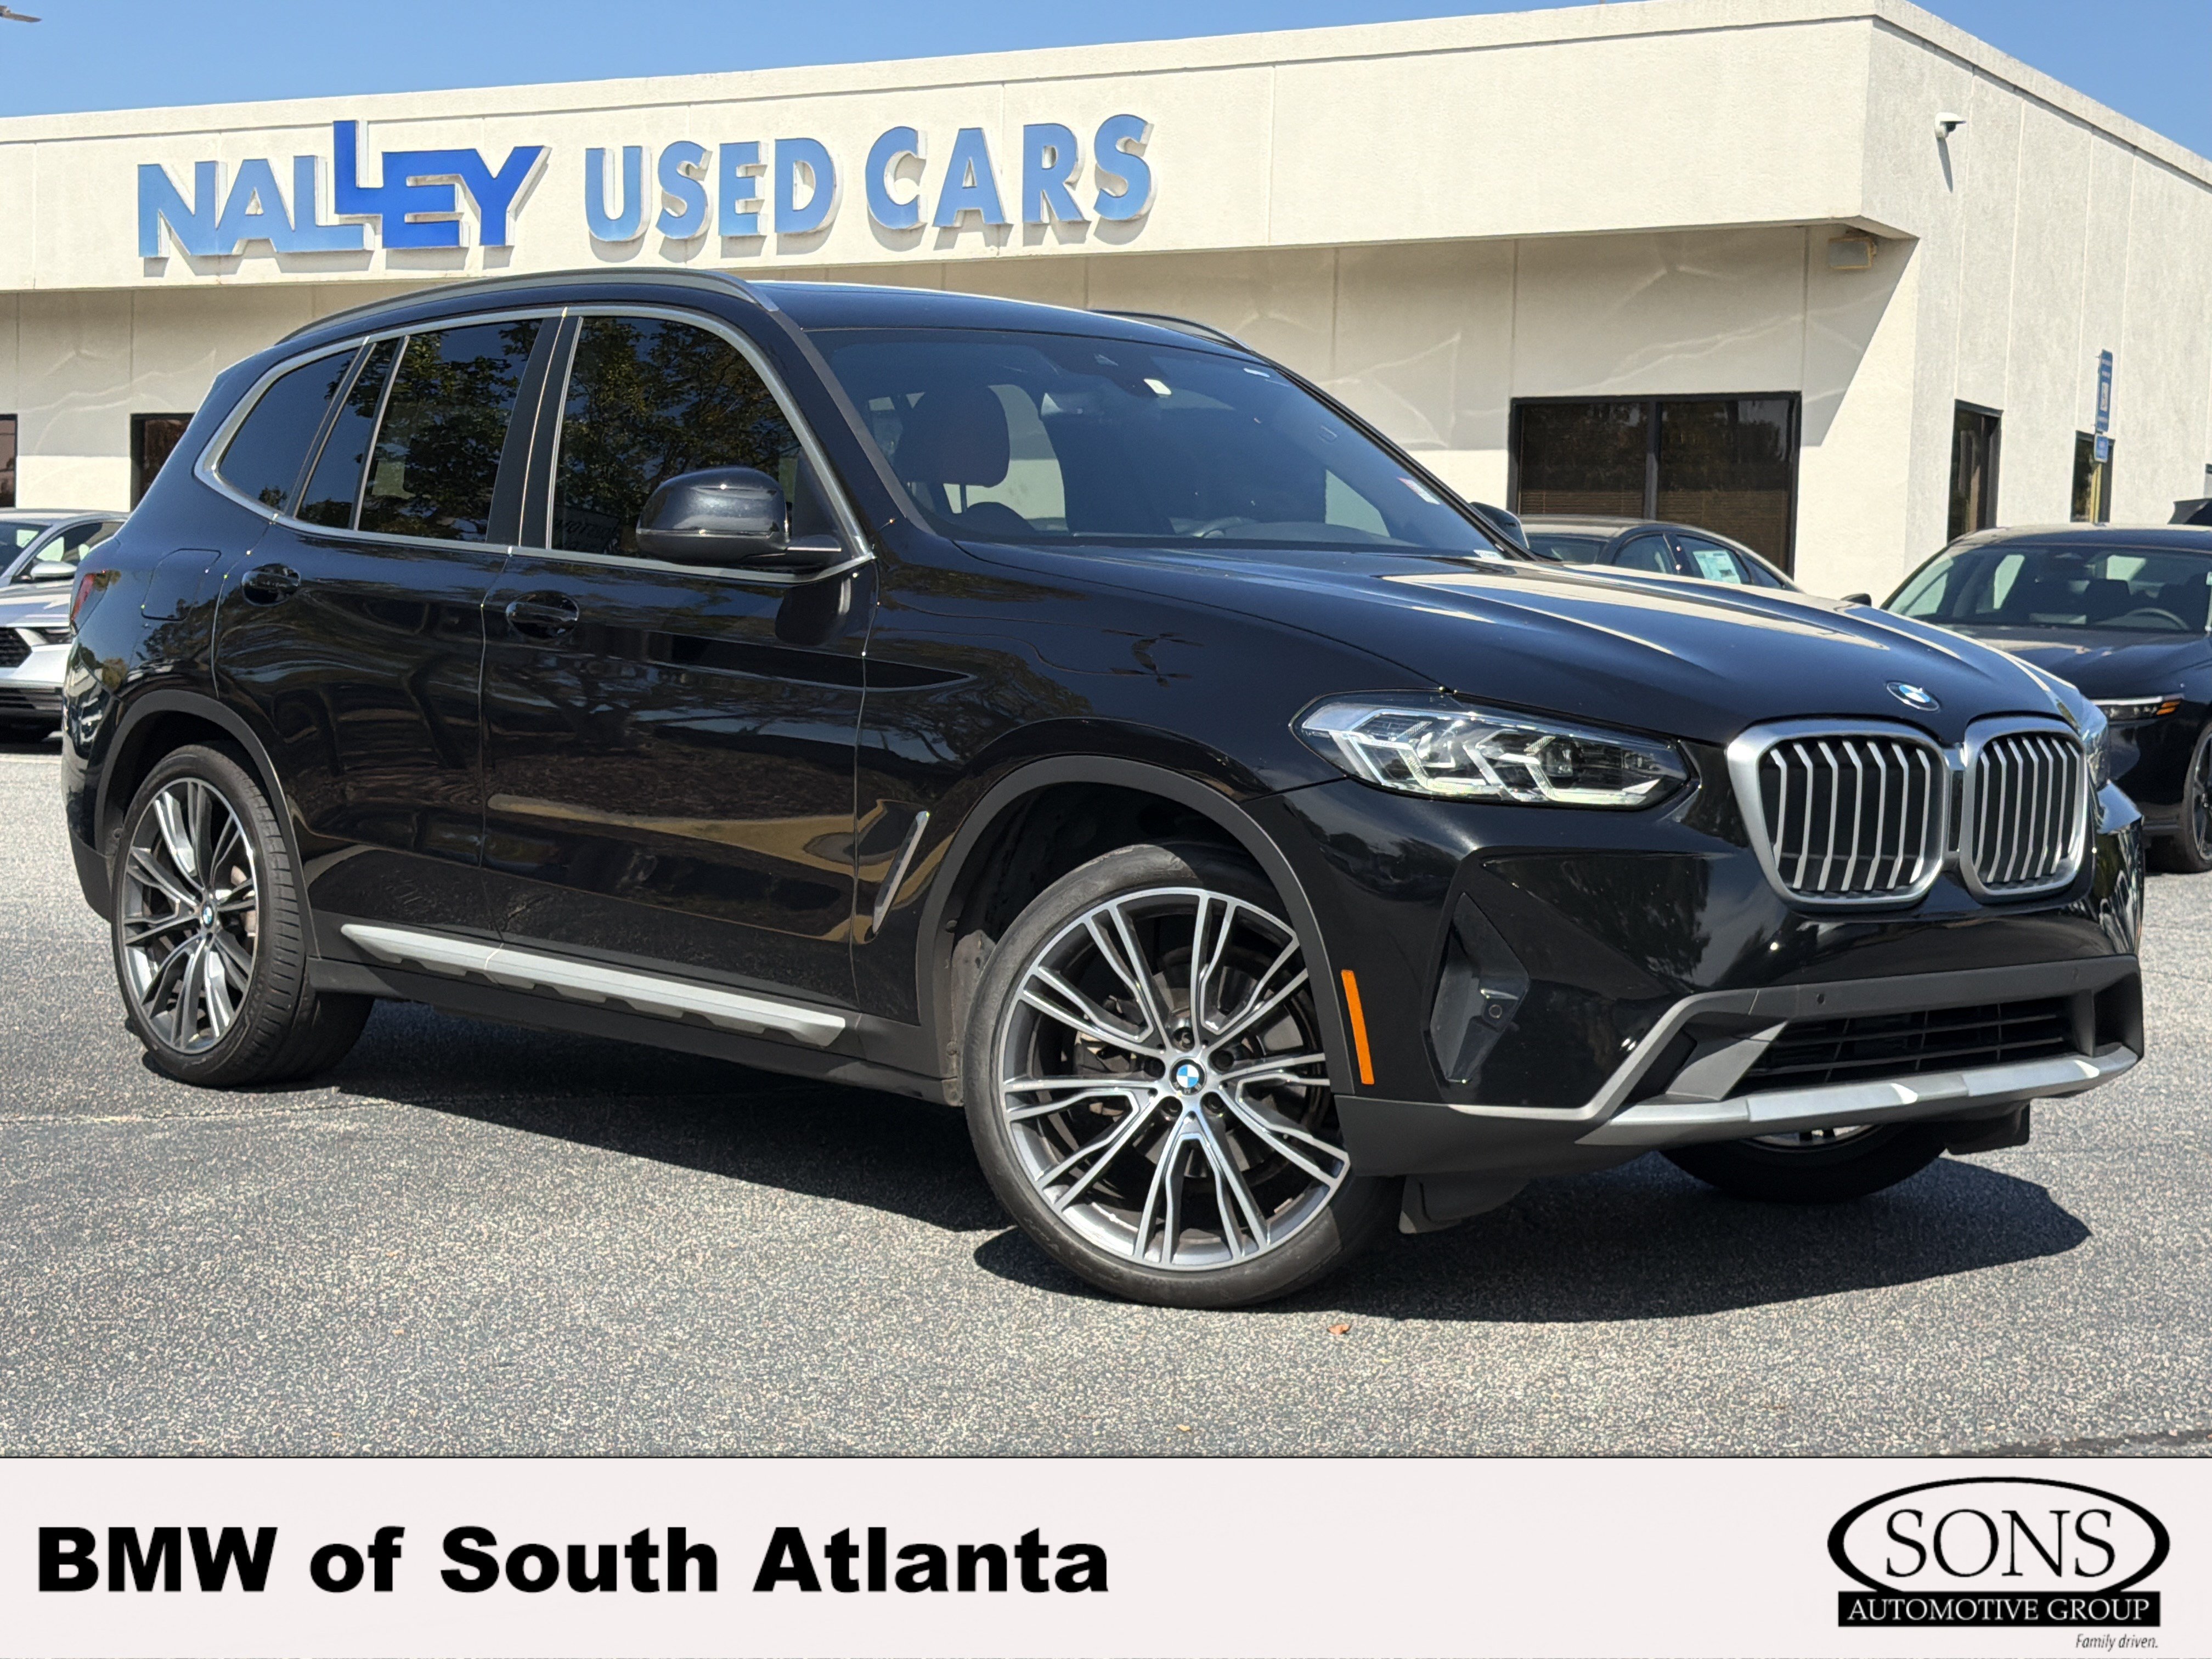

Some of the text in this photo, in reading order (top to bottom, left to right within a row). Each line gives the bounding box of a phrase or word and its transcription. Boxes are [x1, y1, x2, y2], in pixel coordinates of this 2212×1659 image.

[138, 114, 1151, 258] NALLEY USED CARS
